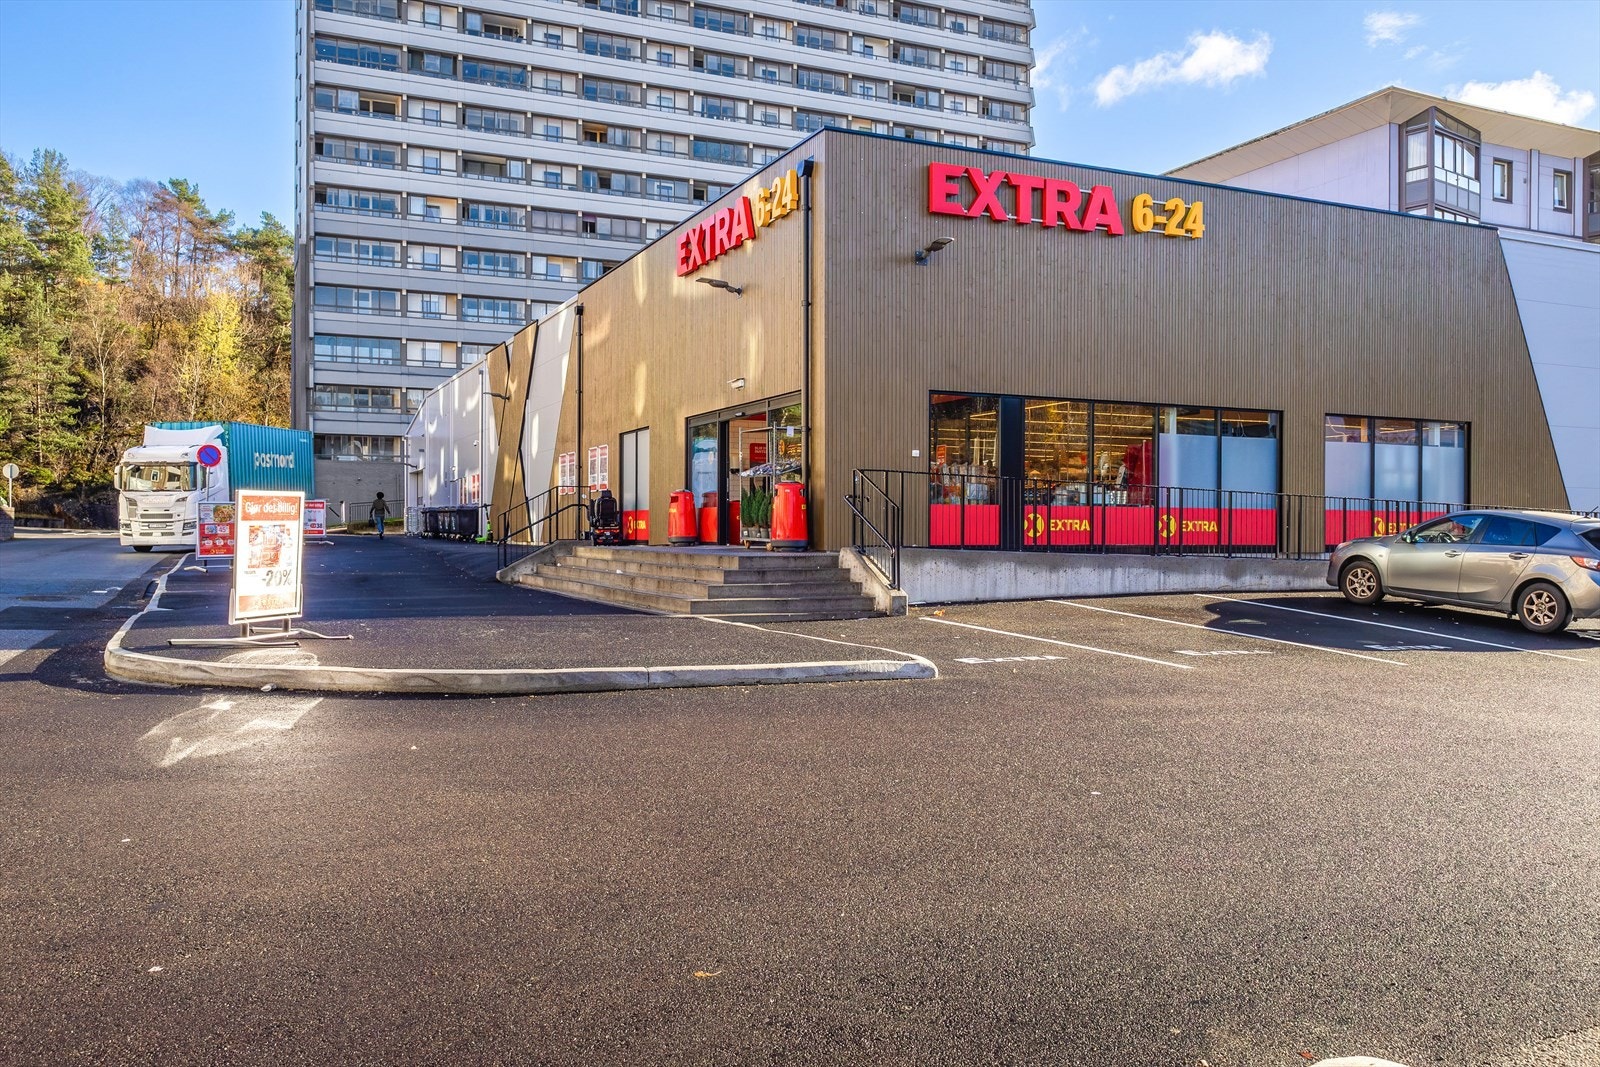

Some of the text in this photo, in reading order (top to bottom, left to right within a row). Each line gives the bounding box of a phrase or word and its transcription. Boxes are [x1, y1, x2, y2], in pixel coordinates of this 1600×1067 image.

[929, 162, 1205, 239] EXTRA 6-24
[677, 169, 798, 277] EXTRA 6-24
[254, 451, 295, 470] postnord
[1050, 519, 1090, 531] EXTRA
[1182, 520, 1218, 532] EXTRA
[261, 569, 293, 587] -20%
